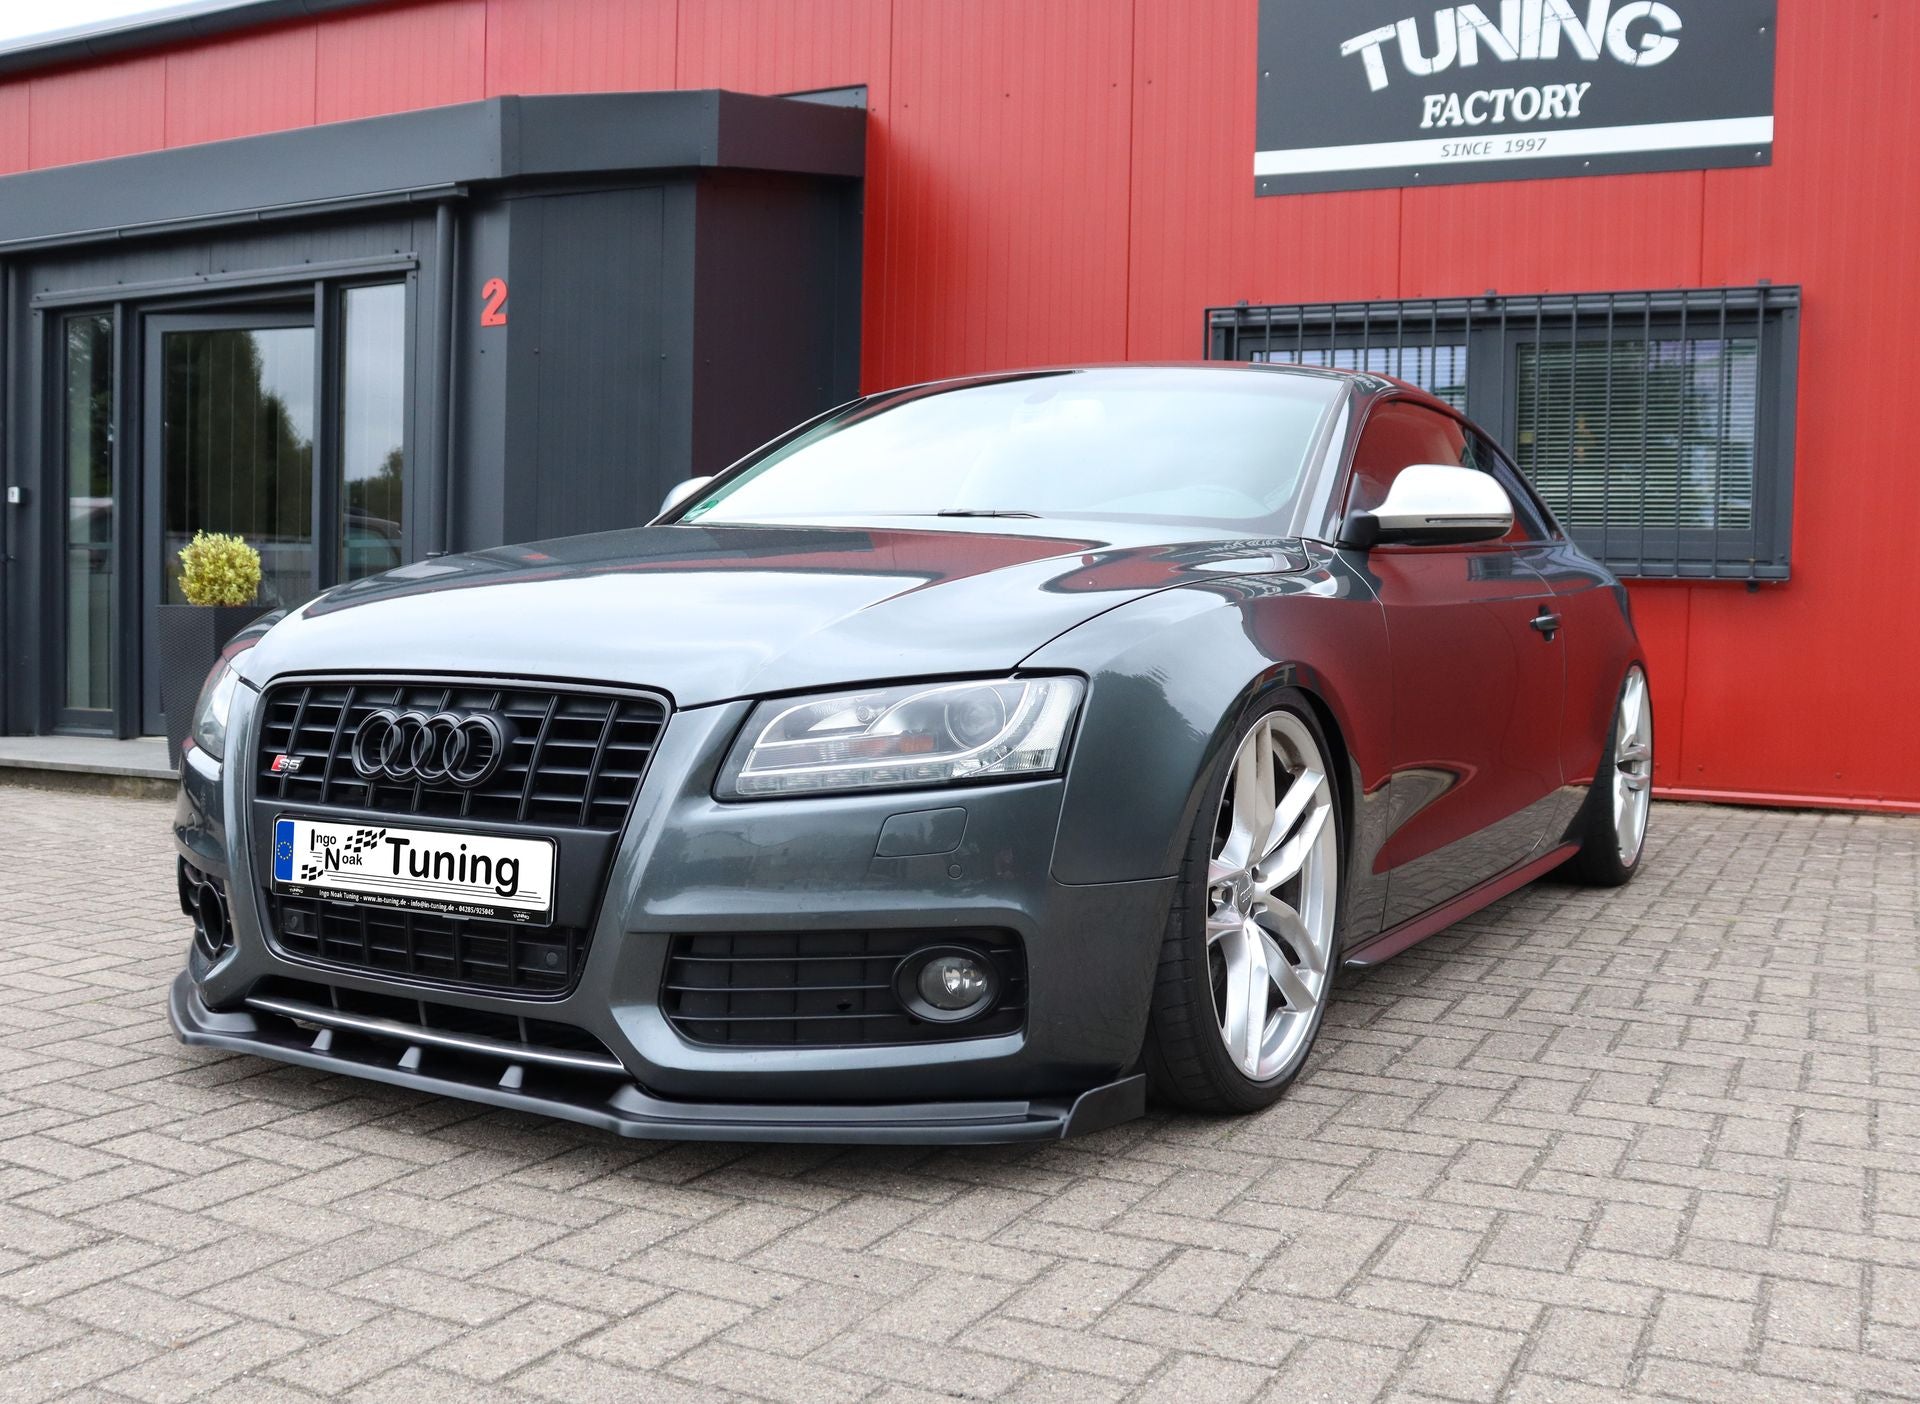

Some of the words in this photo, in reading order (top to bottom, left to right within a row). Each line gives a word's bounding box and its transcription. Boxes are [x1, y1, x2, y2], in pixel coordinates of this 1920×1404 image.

[1340, 0, 1683, 92] TUNING
[1419, 82, 1593, 130] FACTORY
[1440, 141, 1494, 158] SINCE
[1504, 137, 1548, 153] 1997
[480, 277, 508, 328] 2
[310, 829, 337, 851] Ingo
[325, 848, 363, 872] Noak
[385, 837, 520, 897] Tuning
[319, 889, 330, 899] Ingo
[330, 891, 343, 899] Noak
[344, 892, 359, 902] Tuning
[363, 895, 407, 907] www.in-tuning.de
[410, 900, 455, 912] info@in-tuning.de
